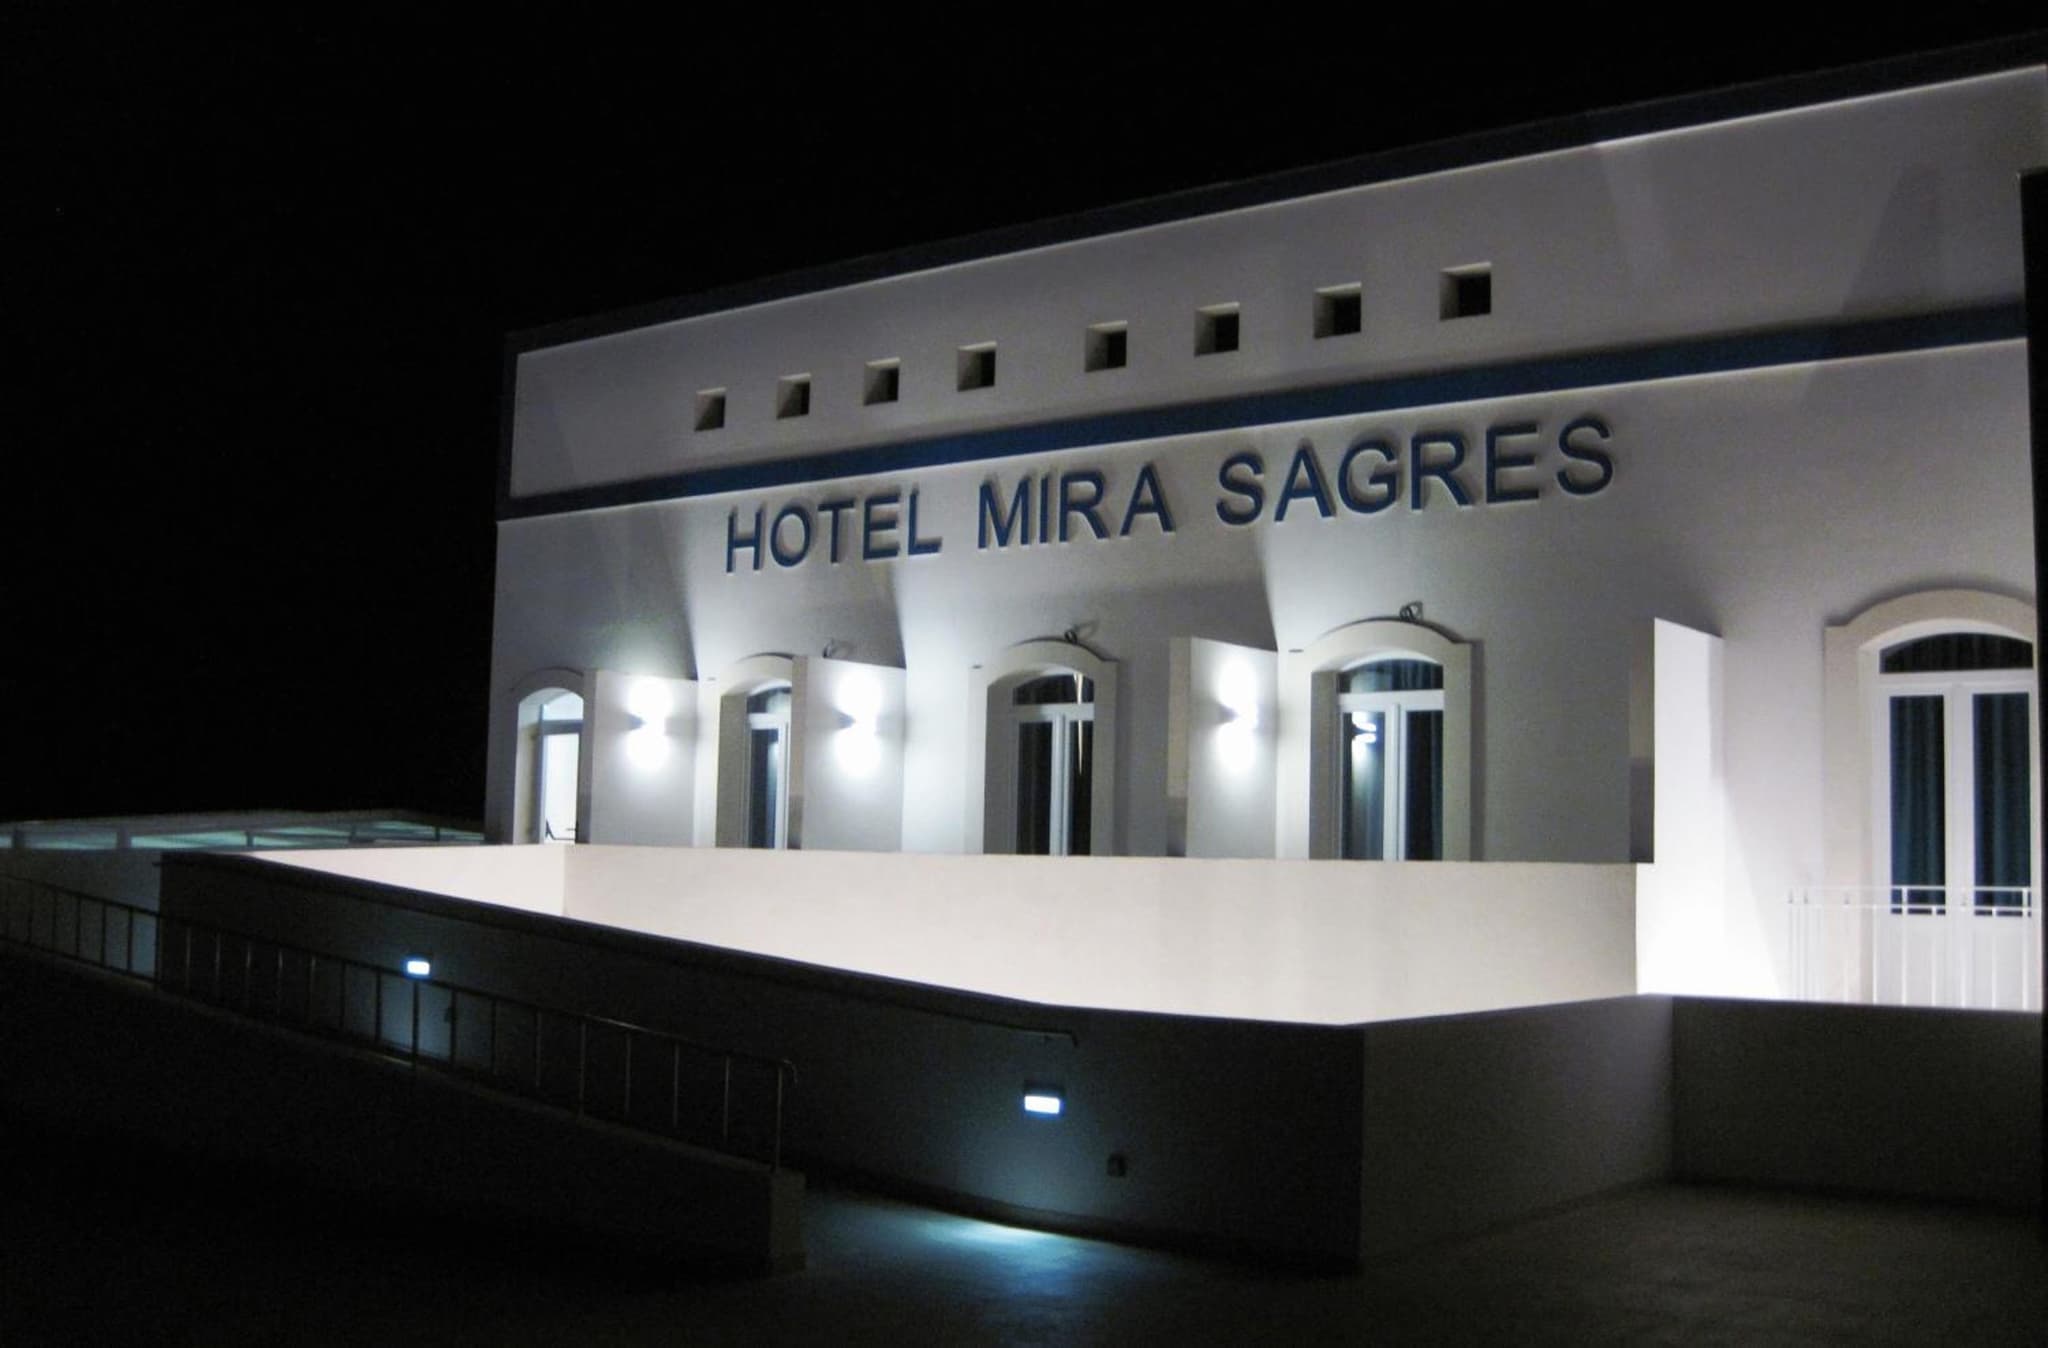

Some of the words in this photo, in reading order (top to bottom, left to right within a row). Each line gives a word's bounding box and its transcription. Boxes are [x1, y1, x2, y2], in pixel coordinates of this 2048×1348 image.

[726, 486, 941, 573] HOTEL
[977, 463, 1176, 549] MIRA
[1216, 417, 1614, 525] SAGRES
